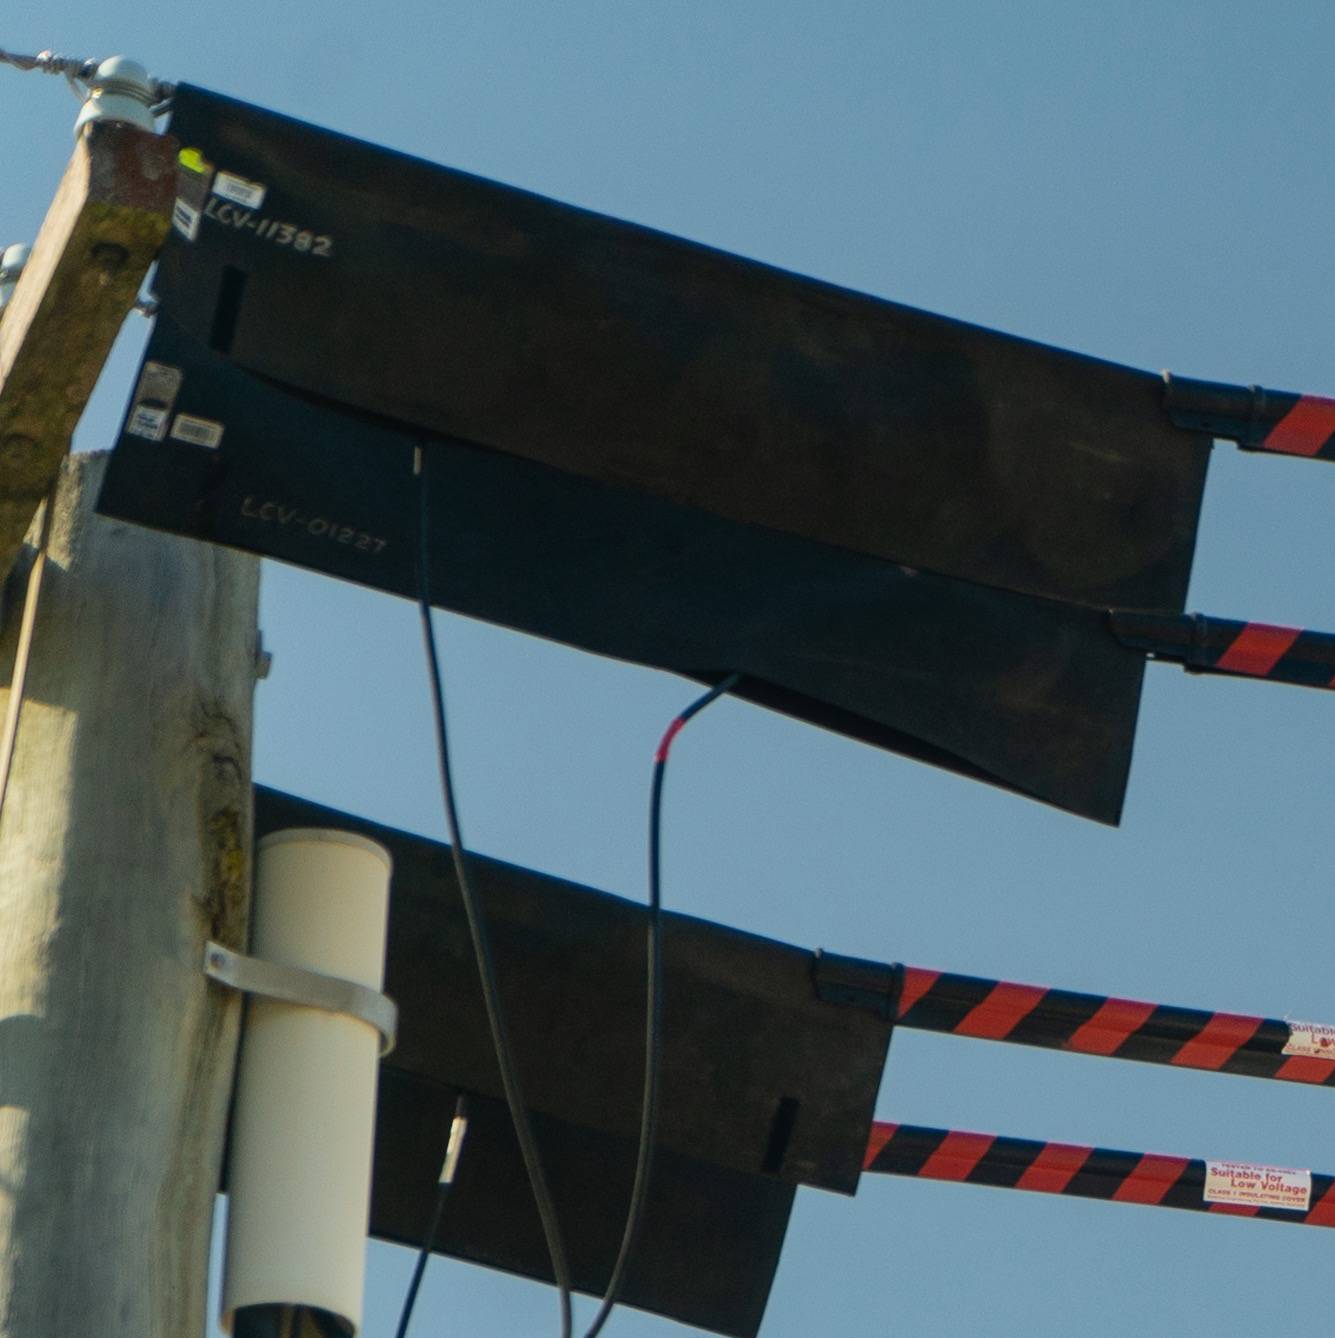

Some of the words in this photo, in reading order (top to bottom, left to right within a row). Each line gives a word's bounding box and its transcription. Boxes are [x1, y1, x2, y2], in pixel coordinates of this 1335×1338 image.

[1210, 1166, 1262, 1180] Suitable
[1264, 1171, 1283, 1184] for
[1230, 1178, 1257, 1190] Low
[1260, 1180, 1308, 1196] Voltage
